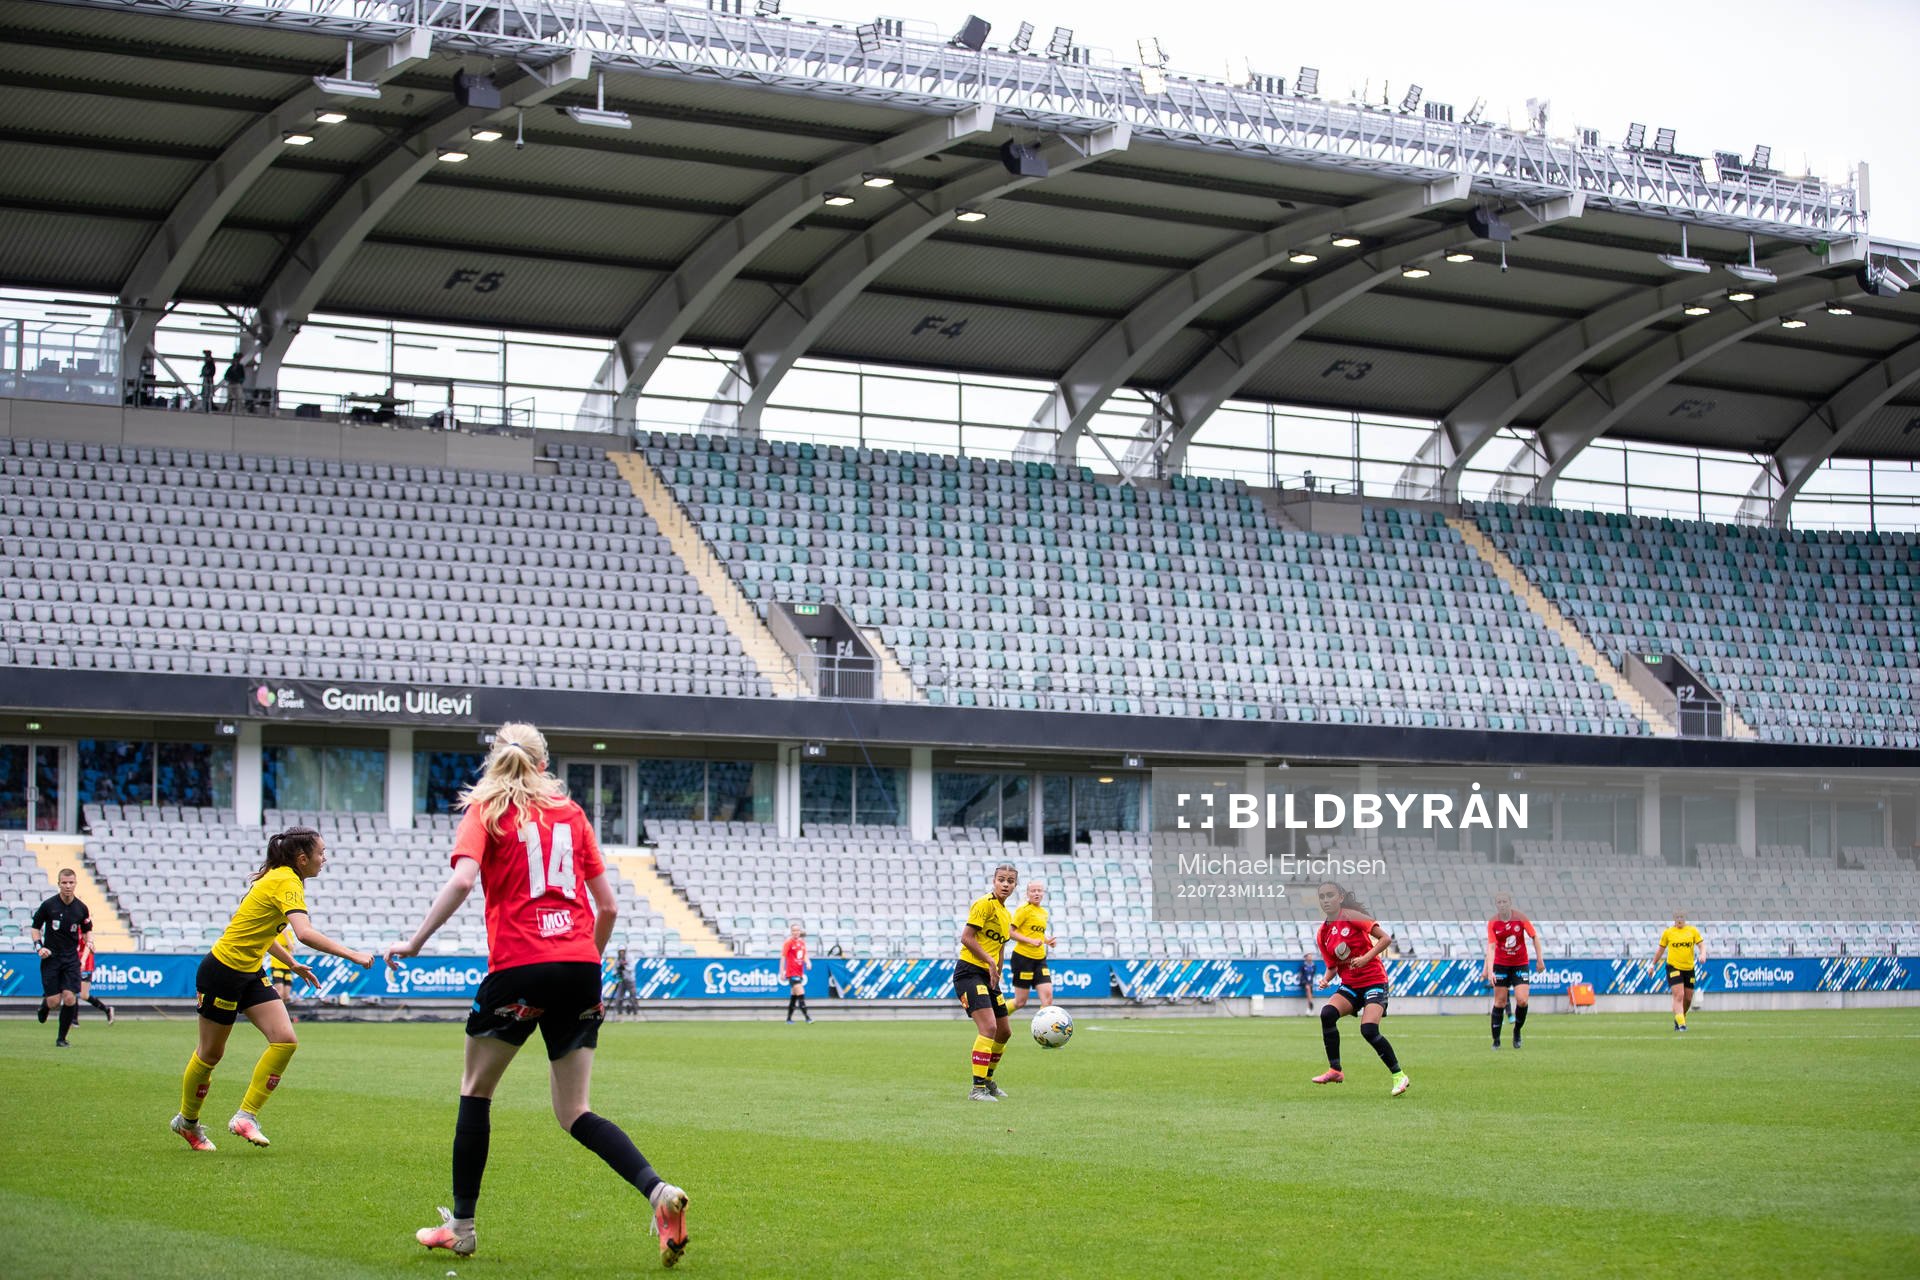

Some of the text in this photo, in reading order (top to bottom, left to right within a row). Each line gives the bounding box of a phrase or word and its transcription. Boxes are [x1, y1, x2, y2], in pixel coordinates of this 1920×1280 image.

[444, 268, 504, 293] F5
[911, 316, 968, 339] F4
[1322, 360, 1372, 380] F3
[278, 699, 304, 709] Event
[322, 688, 472, 716] Gamla Ullevi
[517, 821, 577, 900] 14
[542, 910, 572, 930] MOT
